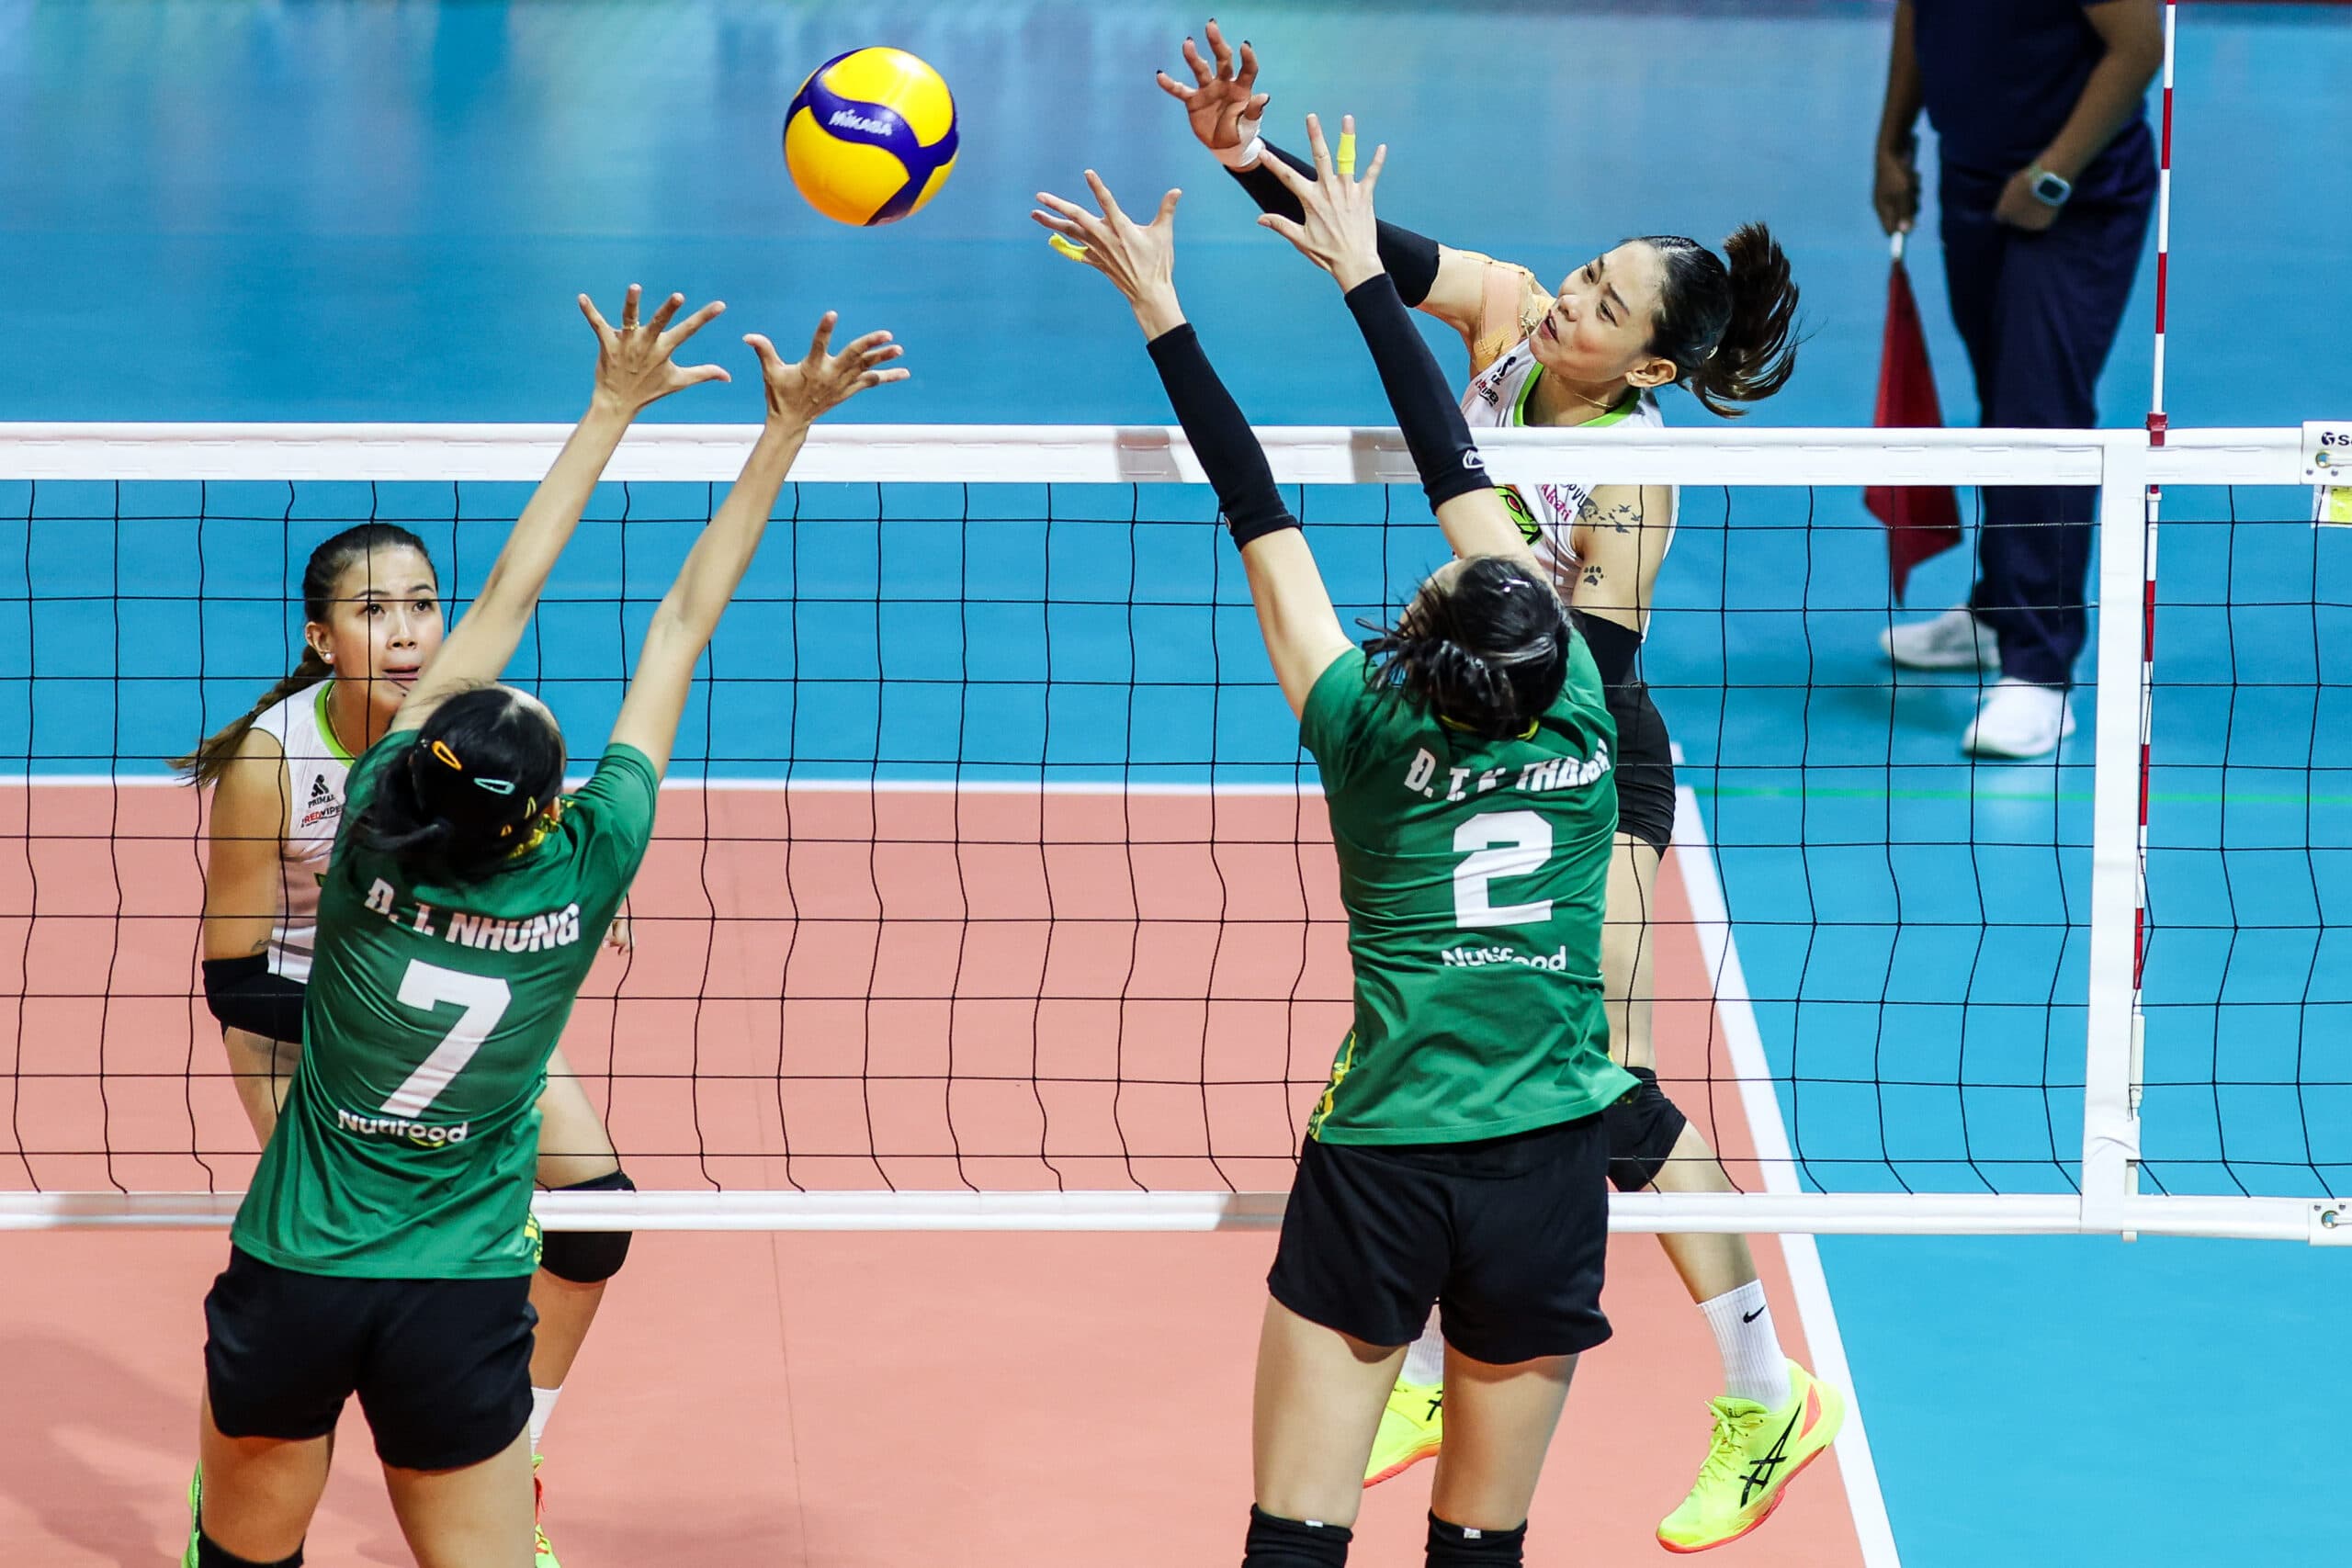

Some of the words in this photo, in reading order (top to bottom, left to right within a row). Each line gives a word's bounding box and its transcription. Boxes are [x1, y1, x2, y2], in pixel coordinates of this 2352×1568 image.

[445, 902, 580, 953] NHUNG
[1453, 810, 1553, 928] 2
[379, 958, 512, 1119] 7
